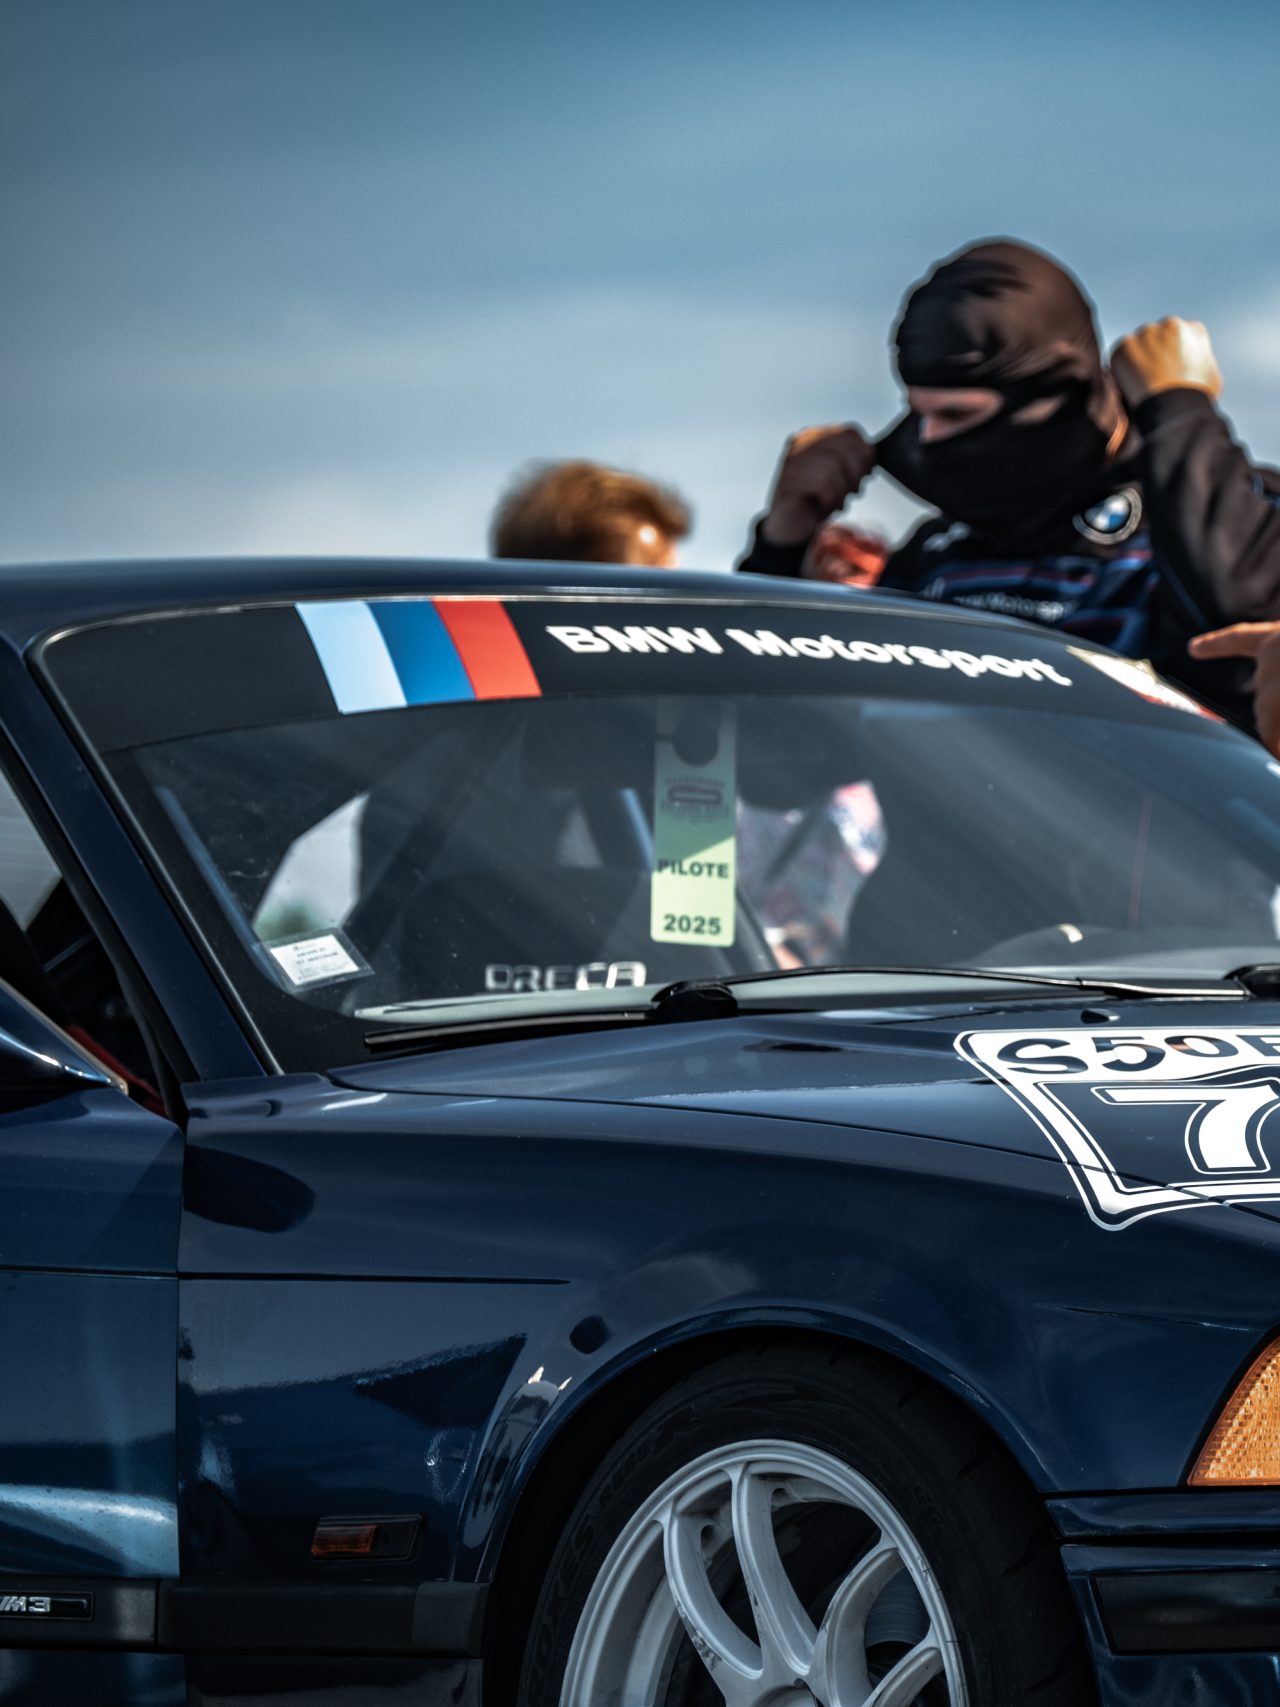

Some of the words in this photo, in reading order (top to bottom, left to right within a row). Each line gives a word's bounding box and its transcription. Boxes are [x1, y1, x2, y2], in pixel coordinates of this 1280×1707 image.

[547, 625, 723, 654] BMW
[727, 628, 1073, 687] Motorsport
[656, 858, 730, 879] PILOTE
[663, 914, 721, 935] 2025
[484, 961, 647, 991] ORECA
